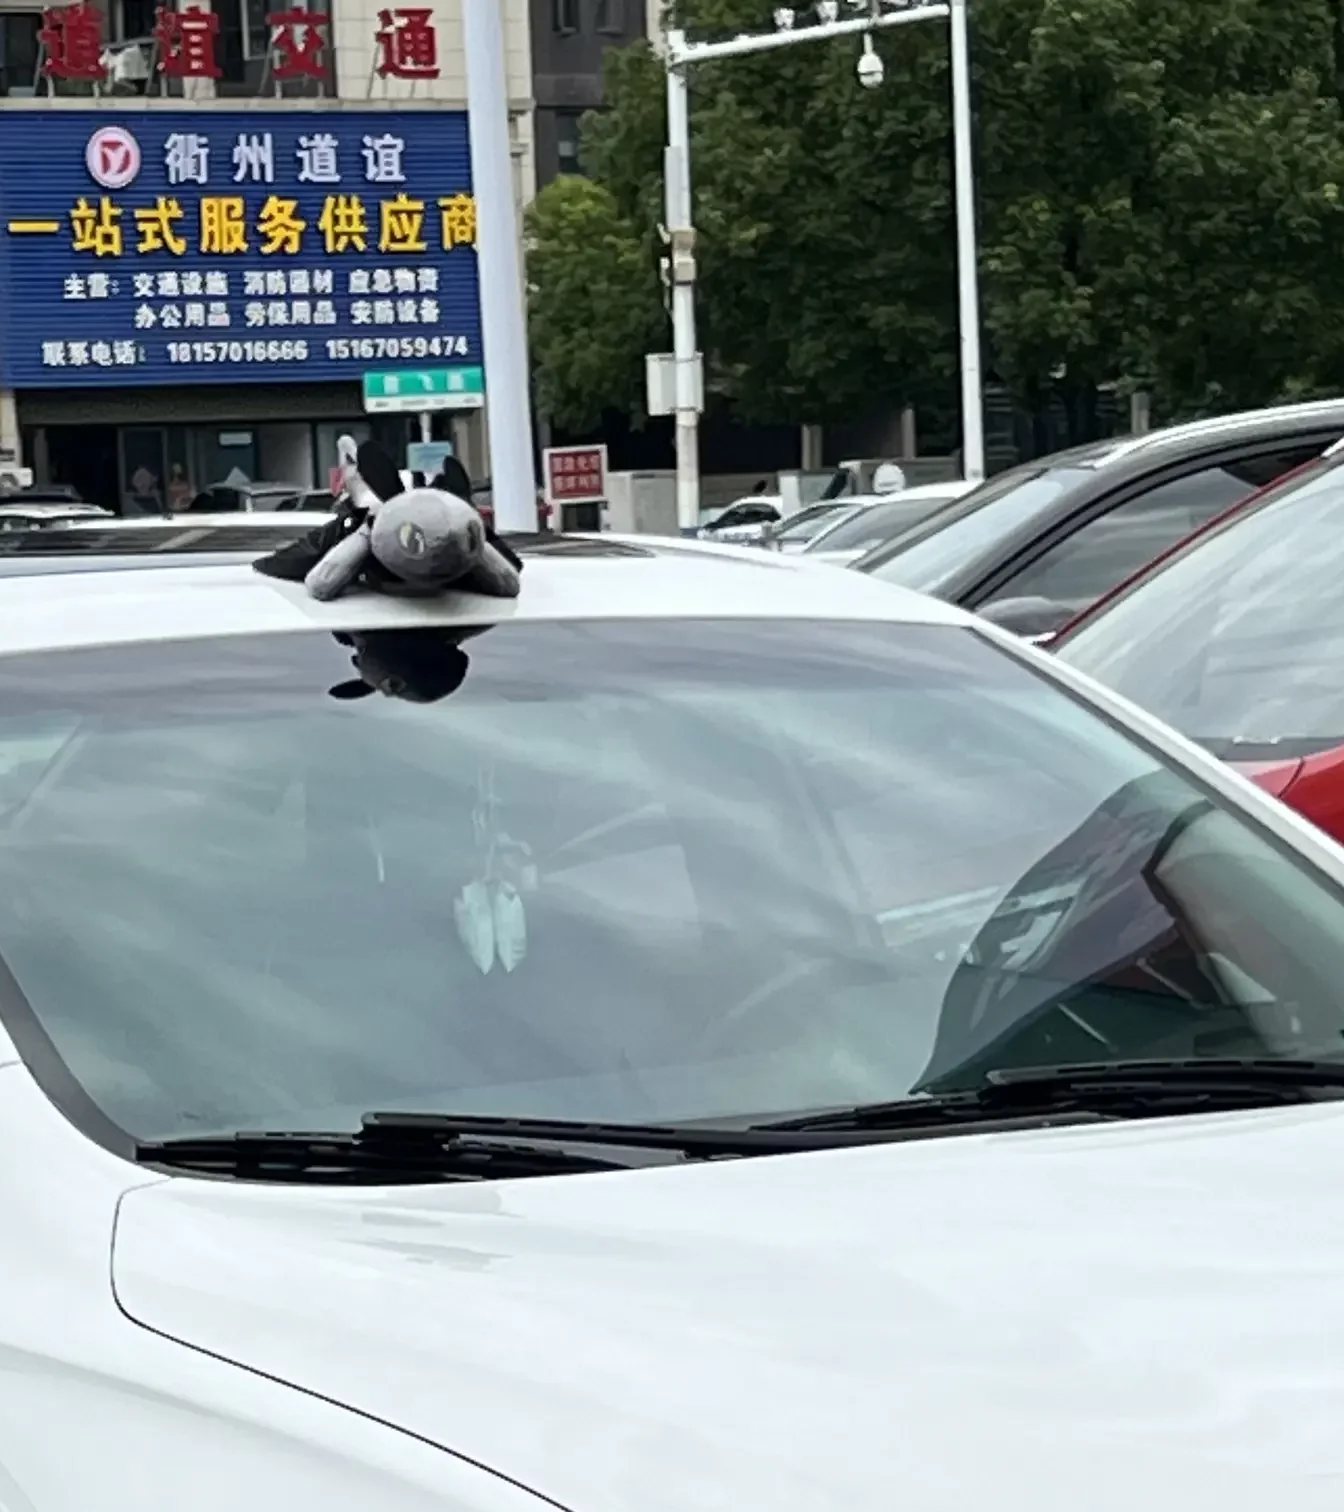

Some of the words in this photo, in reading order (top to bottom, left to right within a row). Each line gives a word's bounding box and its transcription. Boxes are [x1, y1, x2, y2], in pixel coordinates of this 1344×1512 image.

[37, 4, 441, 80] 道谊交通
[164, 132, 406, 184] 衢州道谊
[7, 191, 478, 257] 一站式服务供应商
[132, 270, 229, 297] 交通设施
[134, 301, 231, 329] 办公用品
[244, 300, 337, 327] 劳保用品
[350, 297, 440, 325] 安防设备
[325, 335, 469, 360] 15167059474
